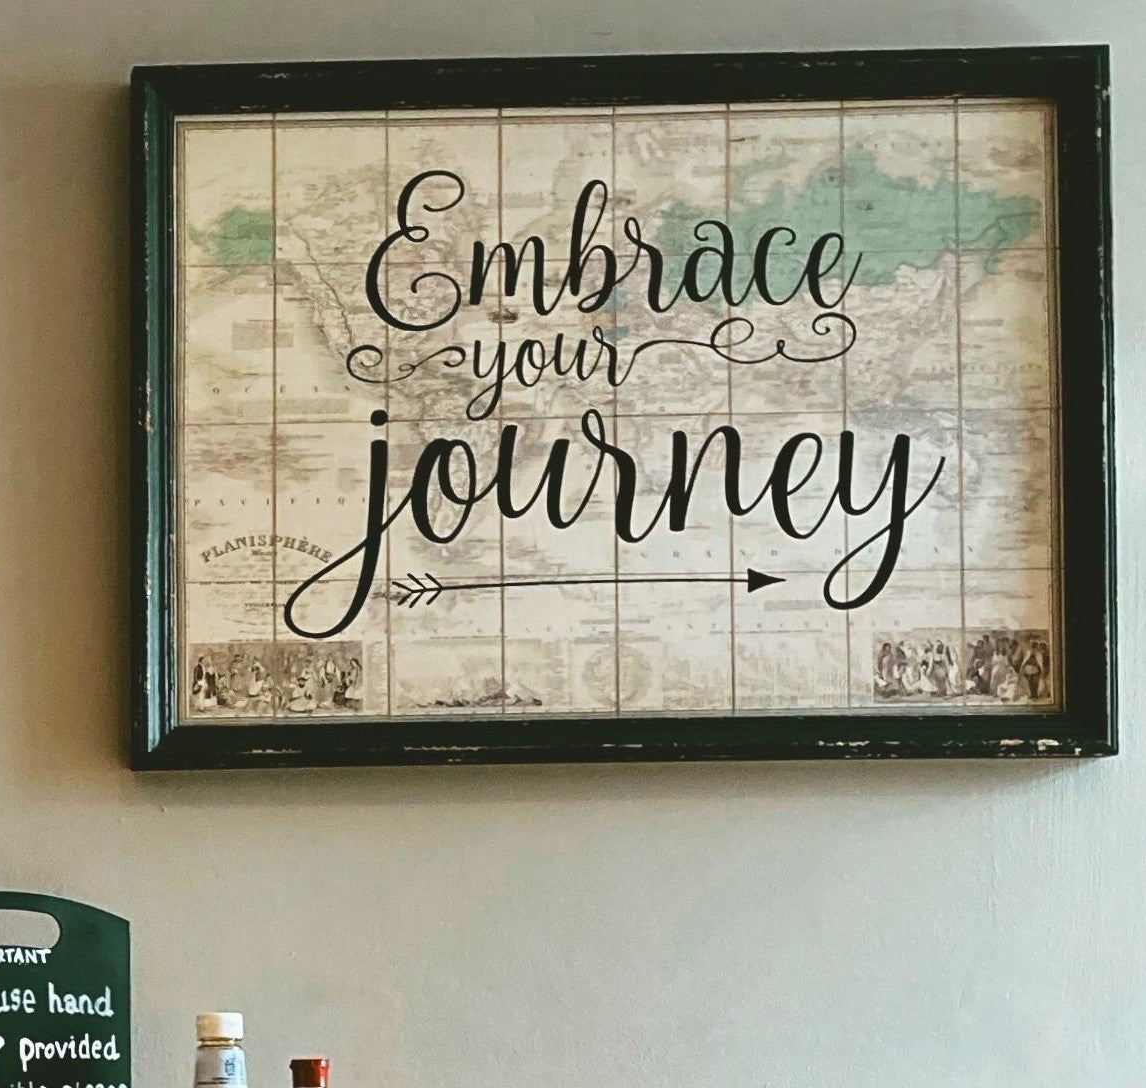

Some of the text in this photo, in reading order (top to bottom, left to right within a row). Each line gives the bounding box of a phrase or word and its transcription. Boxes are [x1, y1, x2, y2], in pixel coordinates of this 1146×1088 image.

[365, 170, 863, 331] Embrace
[465, 325, 636, 421] your
[201, 535, 332, 563] PLANISPHÈRE
[284, 409, 946, 639] journey
[48, 981, 114, 1017] hand
[19, 1033, 121, 1072] provided
